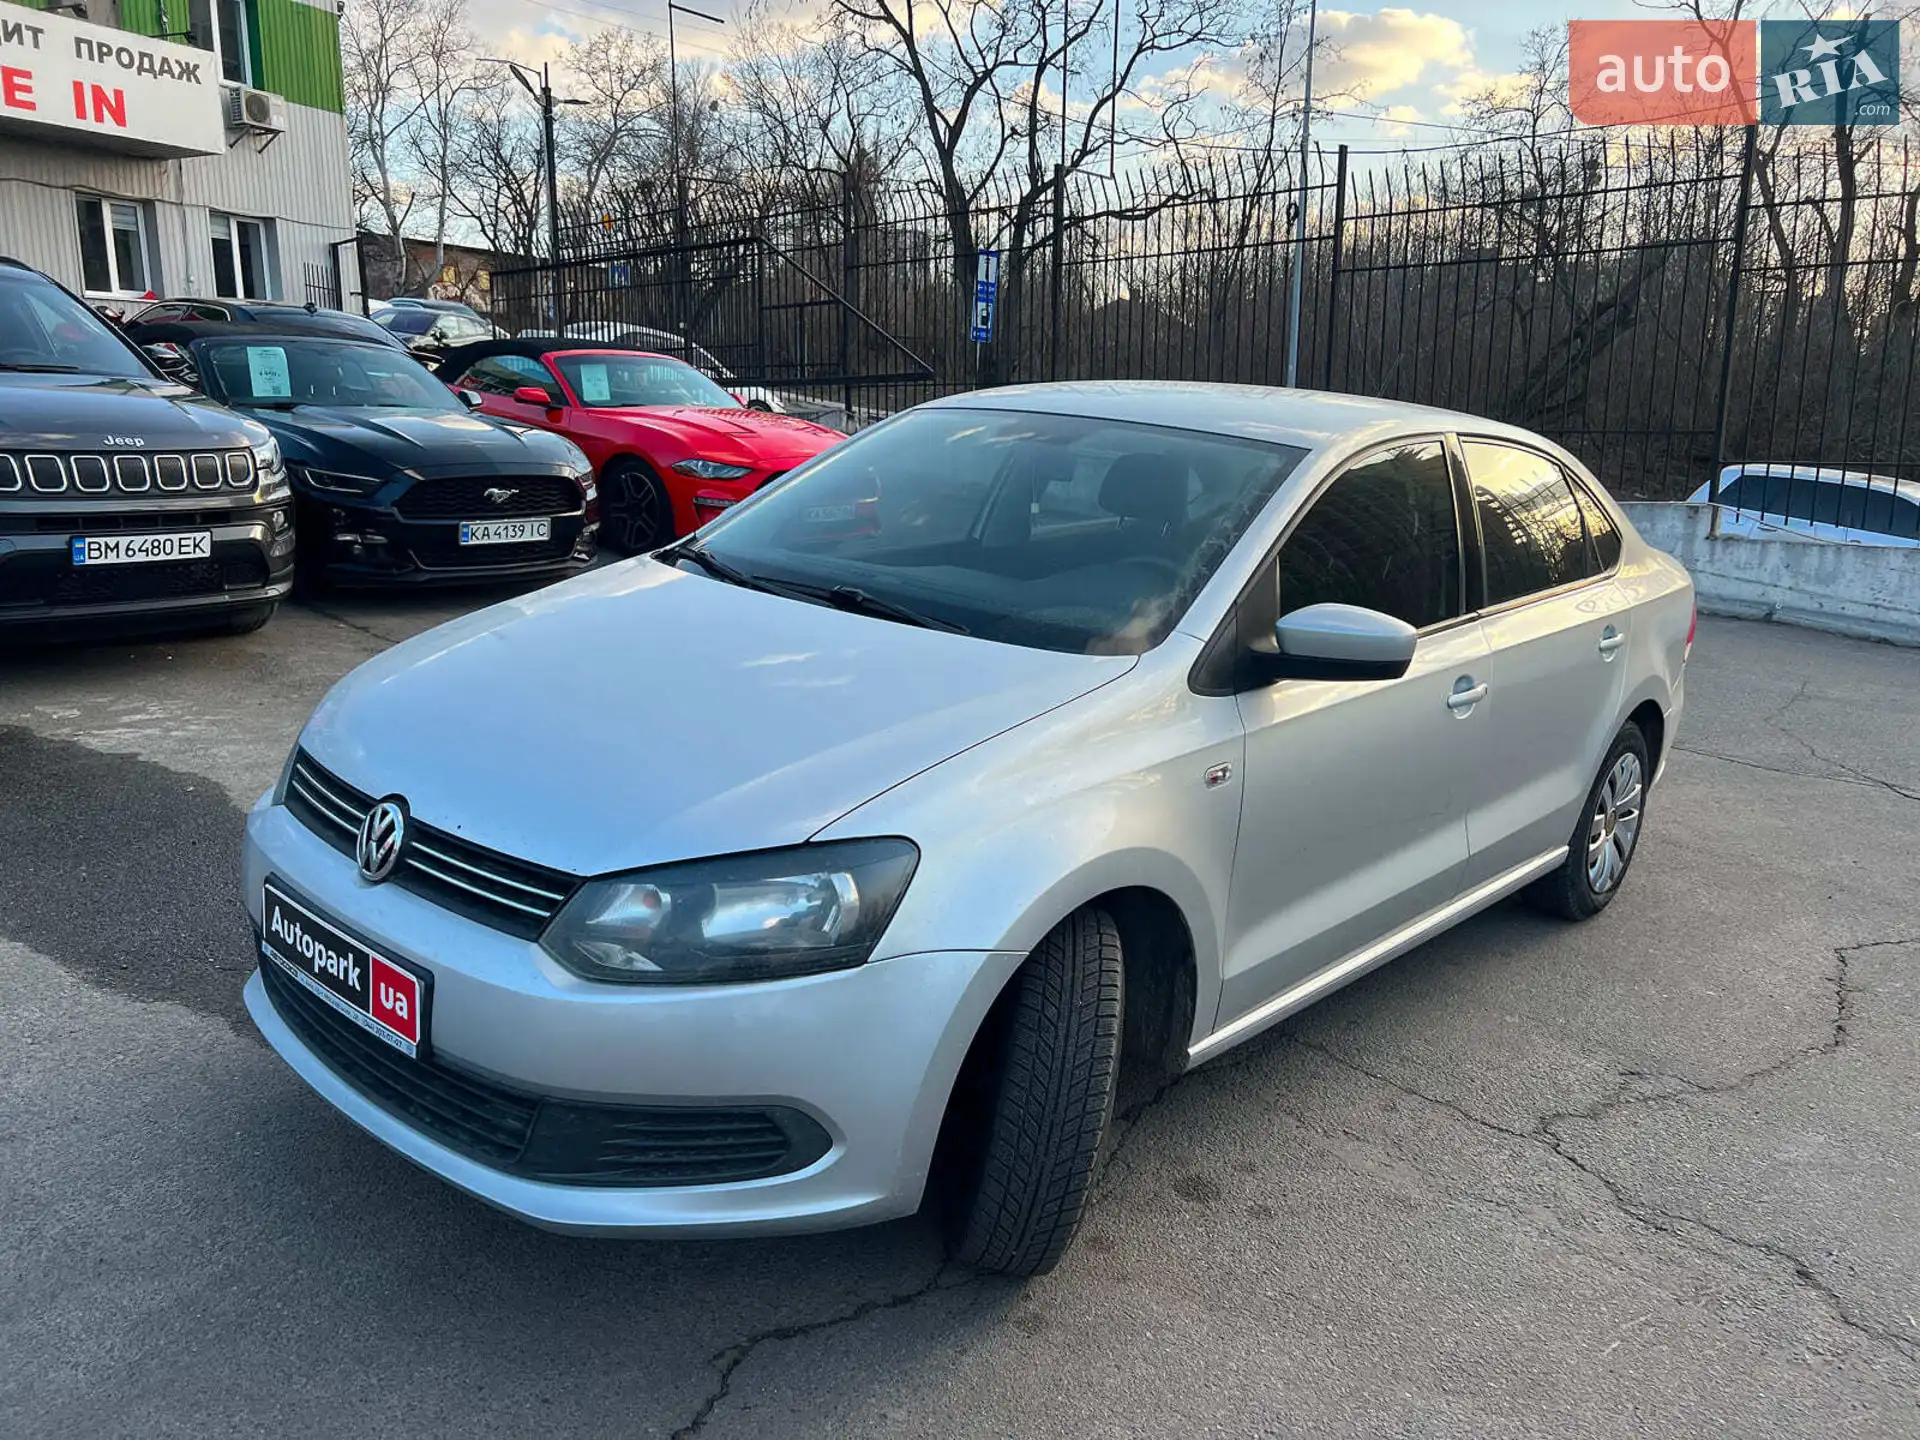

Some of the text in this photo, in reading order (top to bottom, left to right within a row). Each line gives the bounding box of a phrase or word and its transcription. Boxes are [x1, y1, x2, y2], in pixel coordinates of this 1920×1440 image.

[0, 19, 201, 84] ИТ ПРОДАЖ
[72, 80, 127, 128] IN
[103, 435, 145, 448] Jeep
[87, 536, 207, 560] BM 6480 EK
[494, 524, 525, 539] 4139
[270, 905, 361, 992] Autopark
[379, 981, 409, 1020] ua
